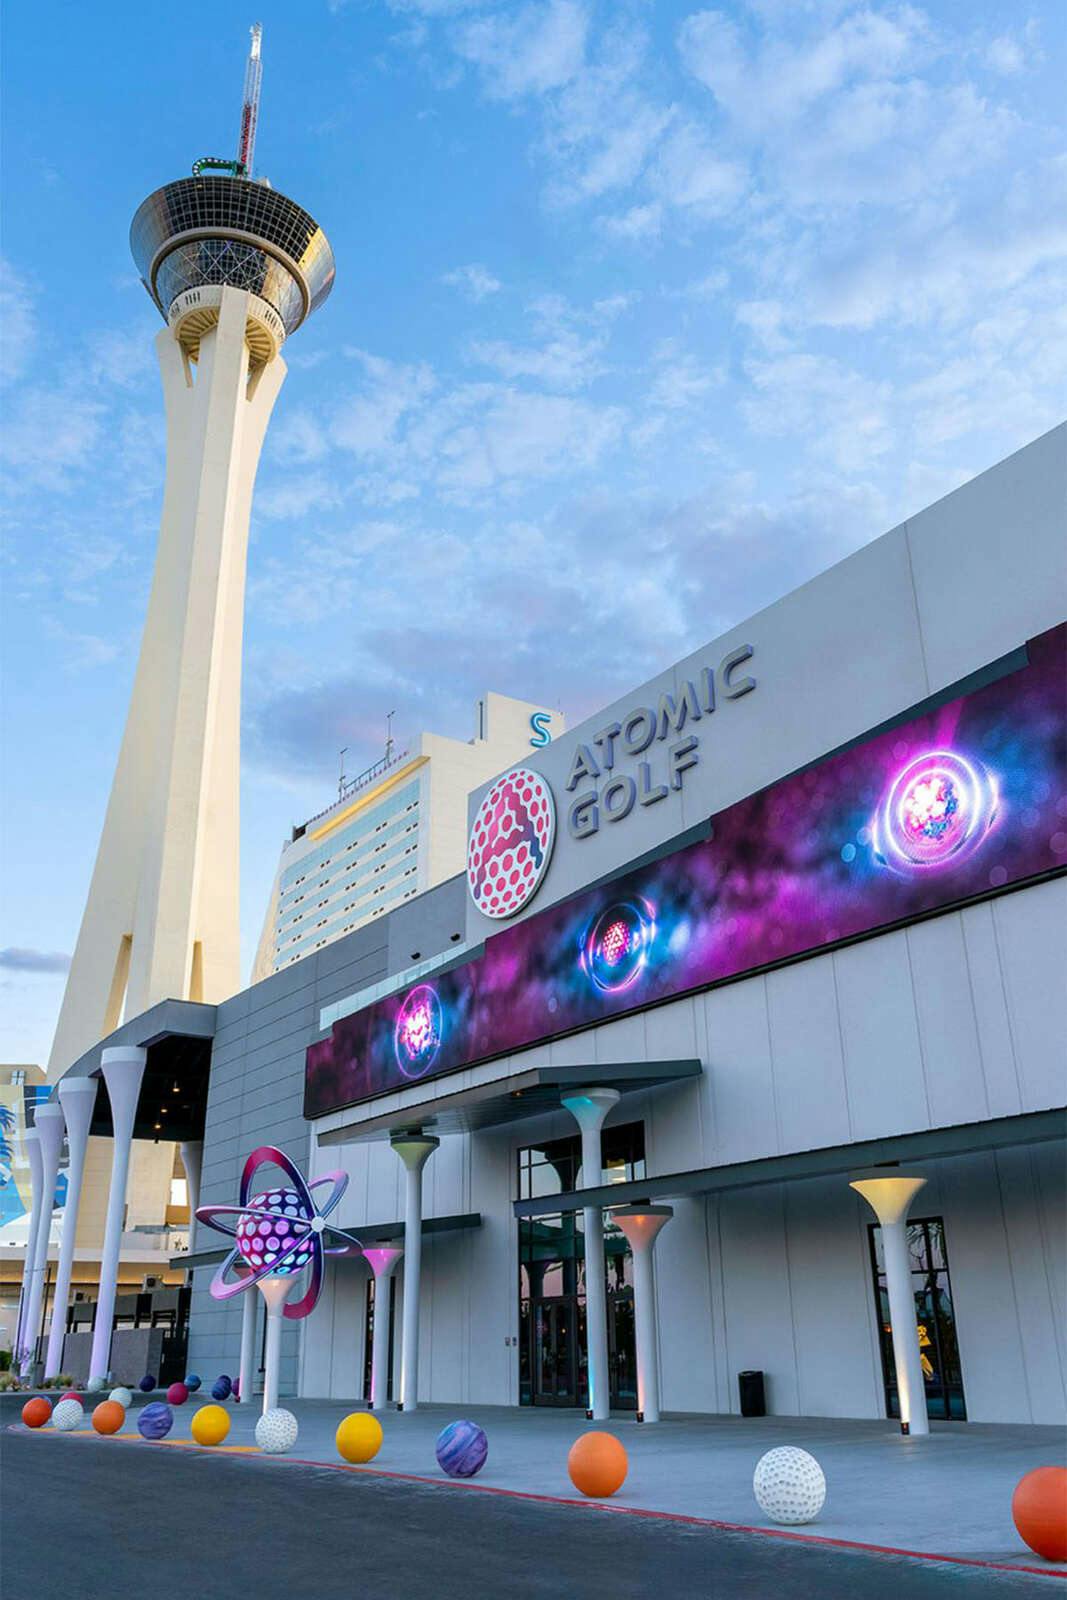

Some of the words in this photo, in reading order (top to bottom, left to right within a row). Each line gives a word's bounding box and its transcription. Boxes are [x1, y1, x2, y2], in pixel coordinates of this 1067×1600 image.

[530, 712, 552, 747] S
[565, 643, 756, 792] ATOMIC
[568, 735, 699, 840] GOLF
